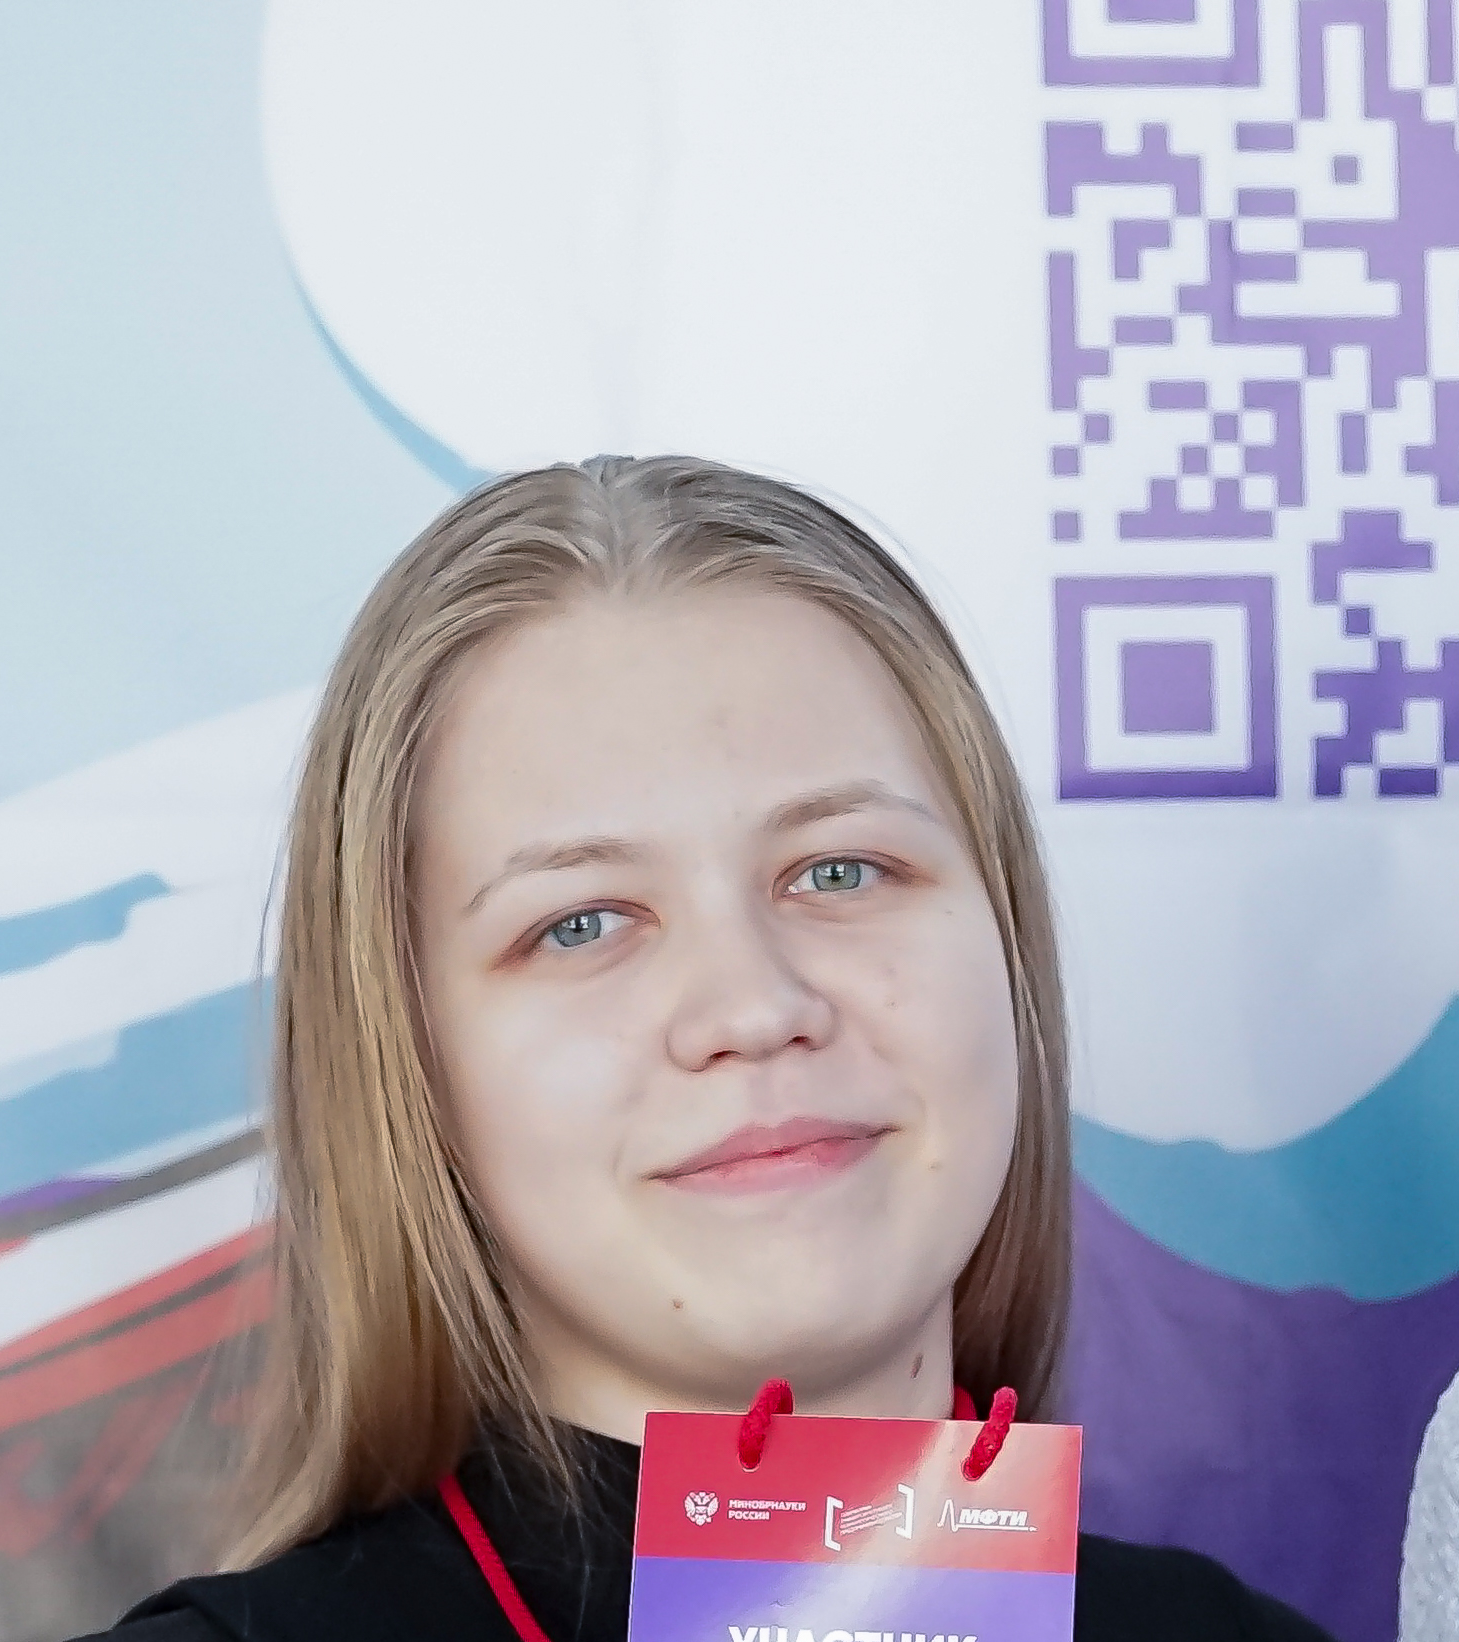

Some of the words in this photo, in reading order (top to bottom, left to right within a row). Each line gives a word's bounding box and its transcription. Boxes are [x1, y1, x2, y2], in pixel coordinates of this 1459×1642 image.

[728, 1499, 807, 1512] МИНОБРНАУКИ
[728, 1510, 770, 1521] РОССИИ
[958, 1508, 1028, 1527] МФТИ
